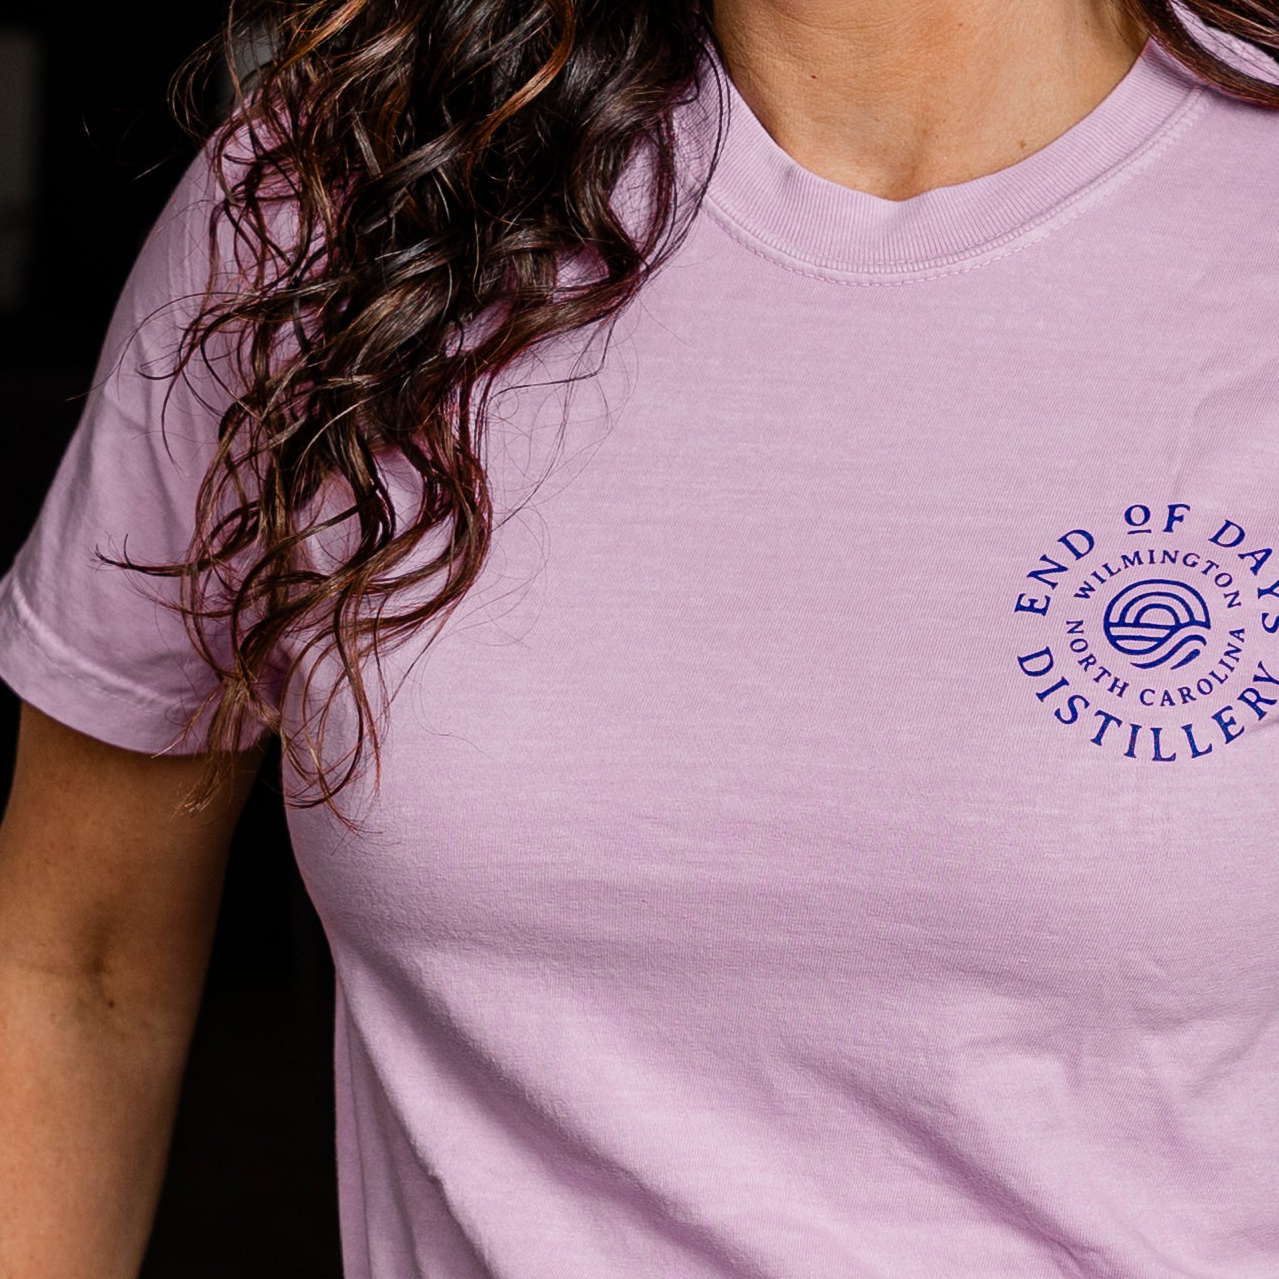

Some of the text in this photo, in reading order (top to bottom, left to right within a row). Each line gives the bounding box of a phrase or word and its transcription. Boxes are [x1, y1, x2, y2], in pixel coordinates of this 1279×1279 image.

[1014, 528, 1096, 616] END
[1123, 503, 1191, 535] OF
[1073, 549, 1242, 609] WILMINGTON
[1065, 619, 1246, 707] NORTH CAROLINA
